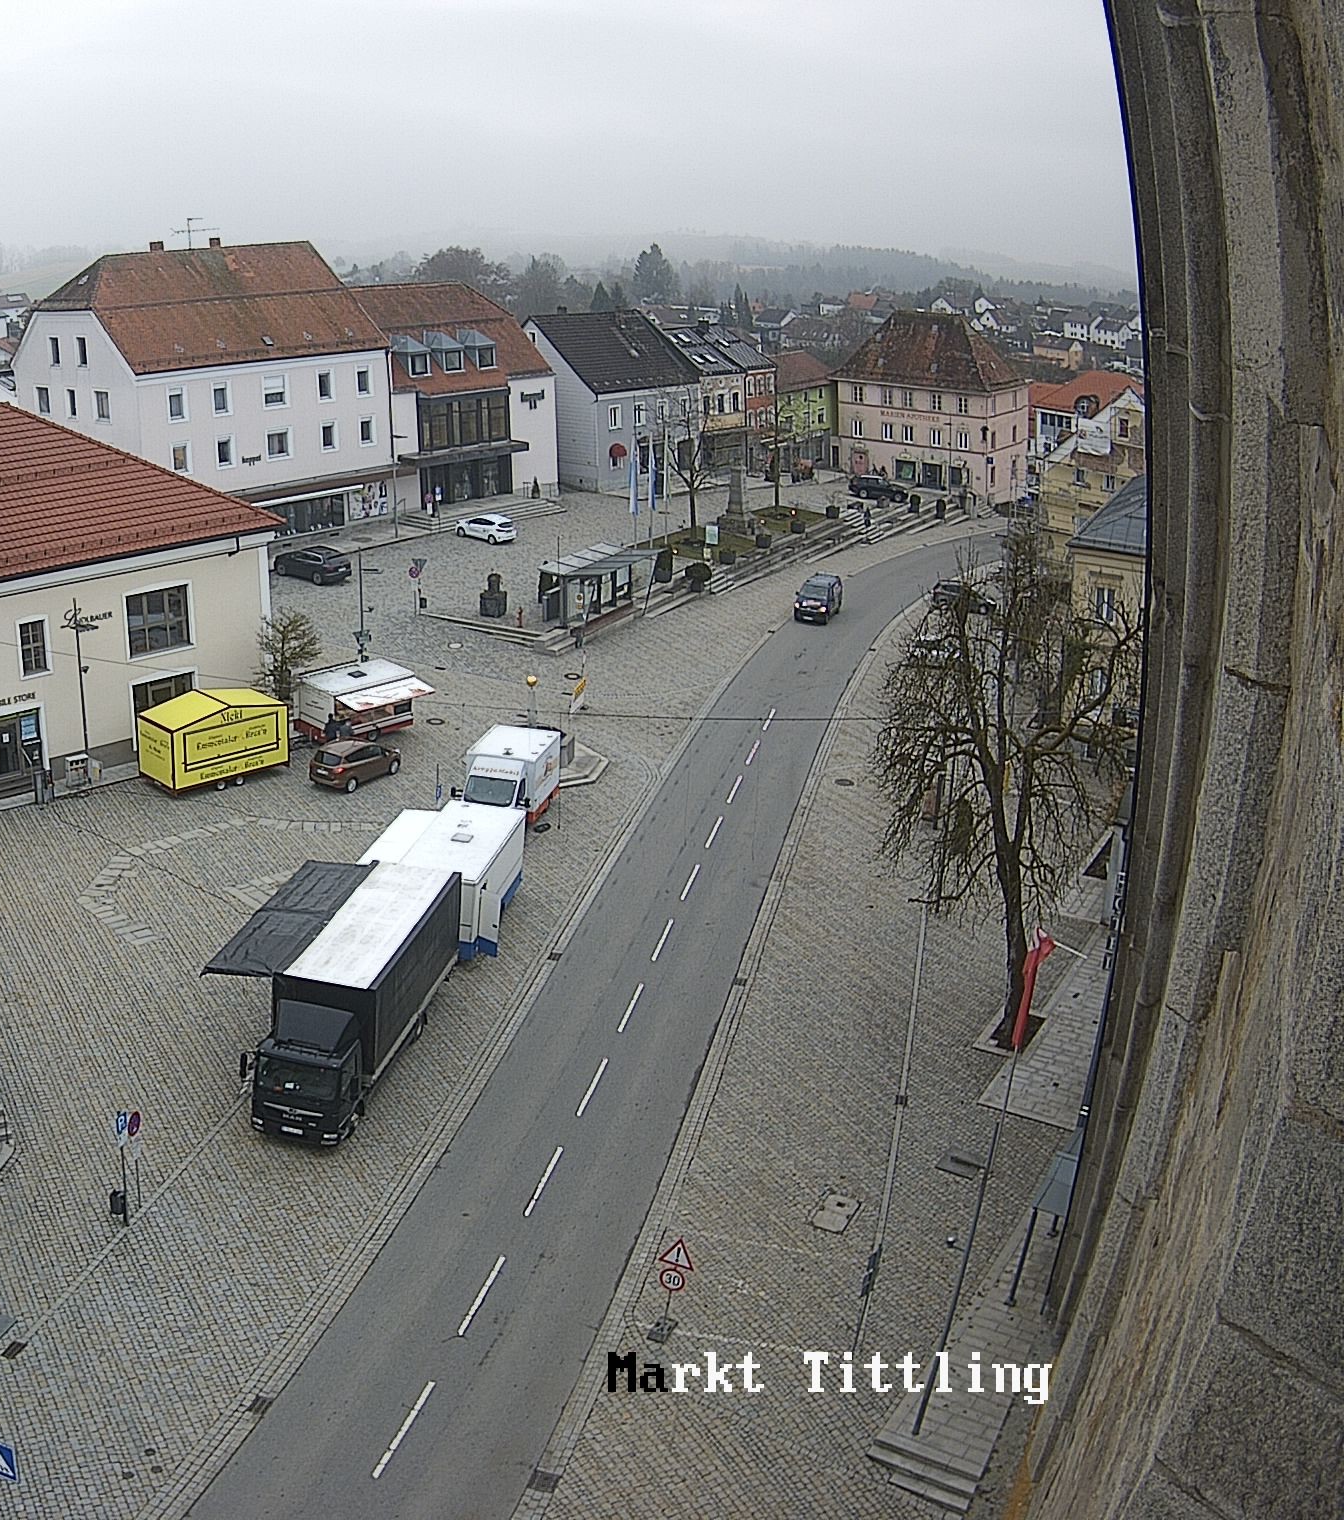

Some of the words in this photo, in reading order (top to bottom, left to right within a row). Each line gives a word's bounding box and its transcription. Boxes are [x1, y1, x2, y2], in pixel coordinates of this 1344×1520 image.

[13, 691, 36, 703] STORE
[282, 1113, 303, 1121] MAN
[665, 1273, 680, 1286] 30
